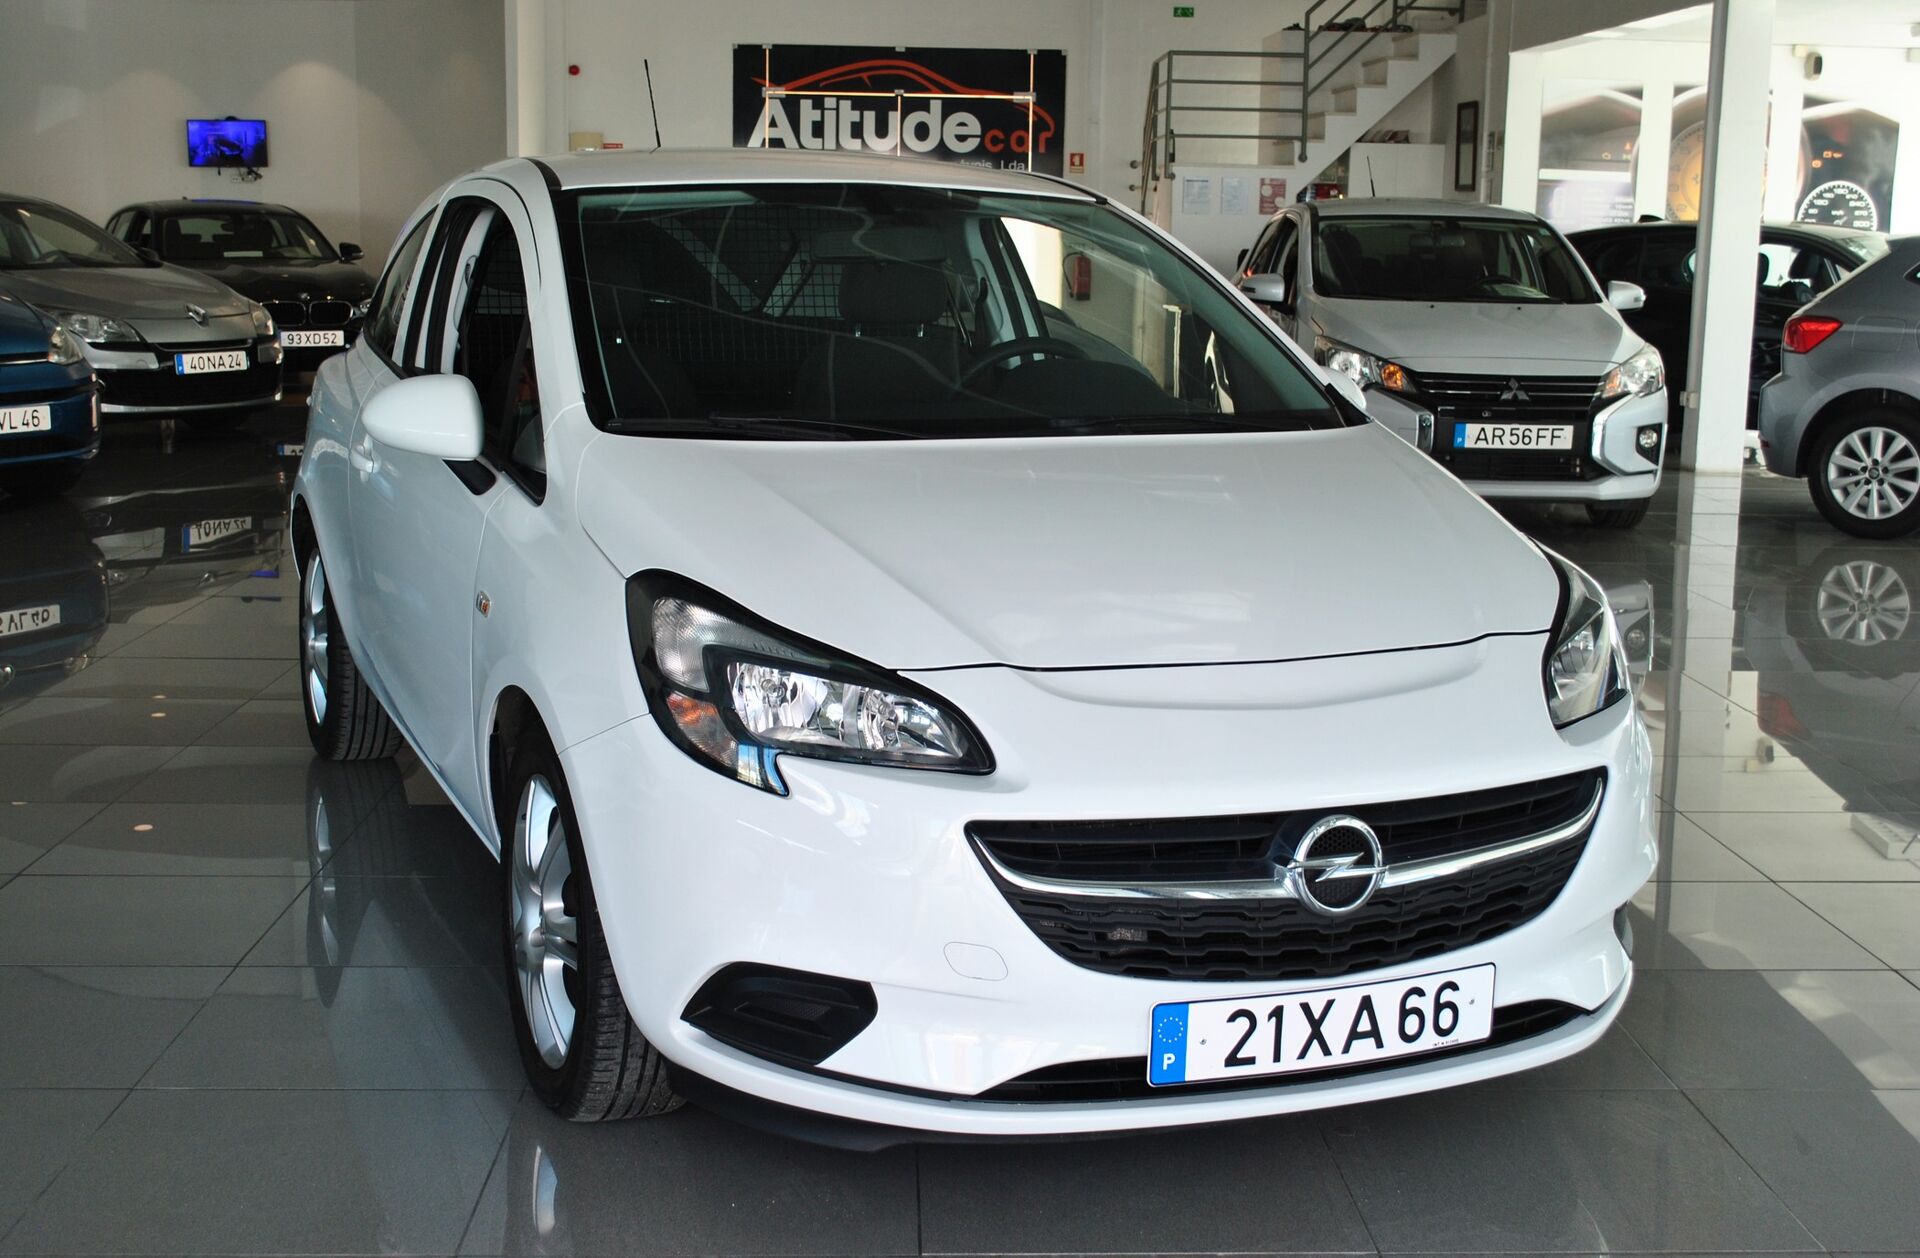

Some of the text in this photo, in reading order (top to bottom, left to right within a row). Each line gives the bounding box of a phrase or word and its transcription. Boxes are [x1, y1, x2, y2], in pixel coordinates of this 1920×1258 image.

[747, 97, 982, 154] Atitude
[287, 333, 337, 345] 93XD52
[190, 354, 241, 370] 40NA24
[1474, 427, 1564, 446] AR56FF
[1162, 980, 1460, 1070] P 21XA66
